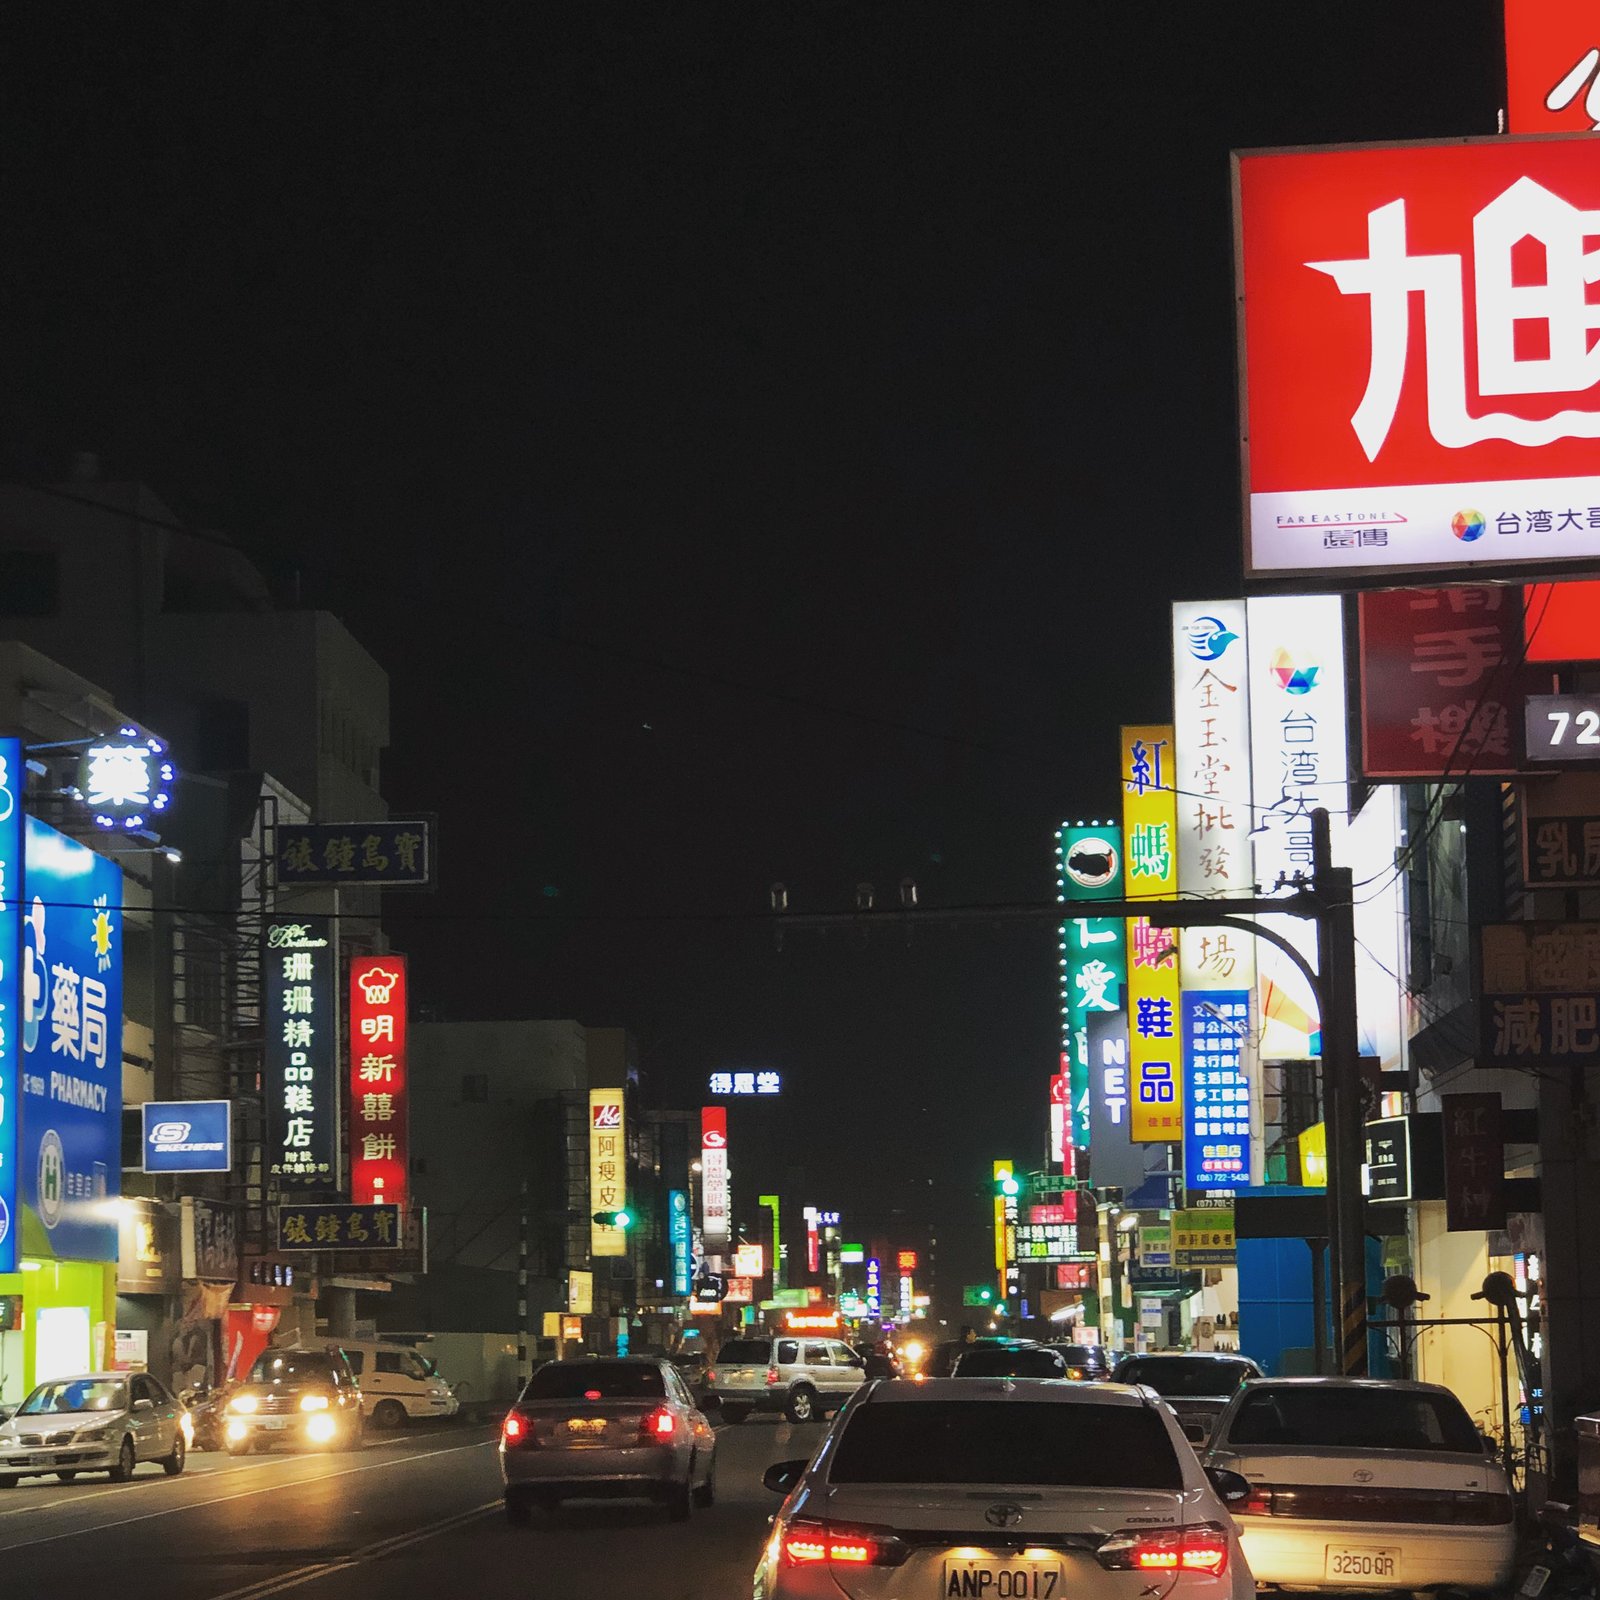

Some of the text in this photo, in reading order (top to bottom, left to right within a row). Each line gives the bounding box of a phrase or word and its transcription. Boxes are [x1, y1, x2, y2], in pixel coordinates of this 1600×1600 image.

[1303, 175, 1600, 462] 旭
[1193, 668, 1237, 978] 金玉堂批發場
[1126, 740, 1176, 1103] 紅螞蟻鞋品
[51, 962, 107, 1070] 藥局
[282, 952, 315, 1147] 珊珊精品鞋店
[1102, 1038, 1126, 1124] NET
[50, 1071, 107, 1113] PHARMACY
[947, 1569, 1060, 1599] ANP-0017
